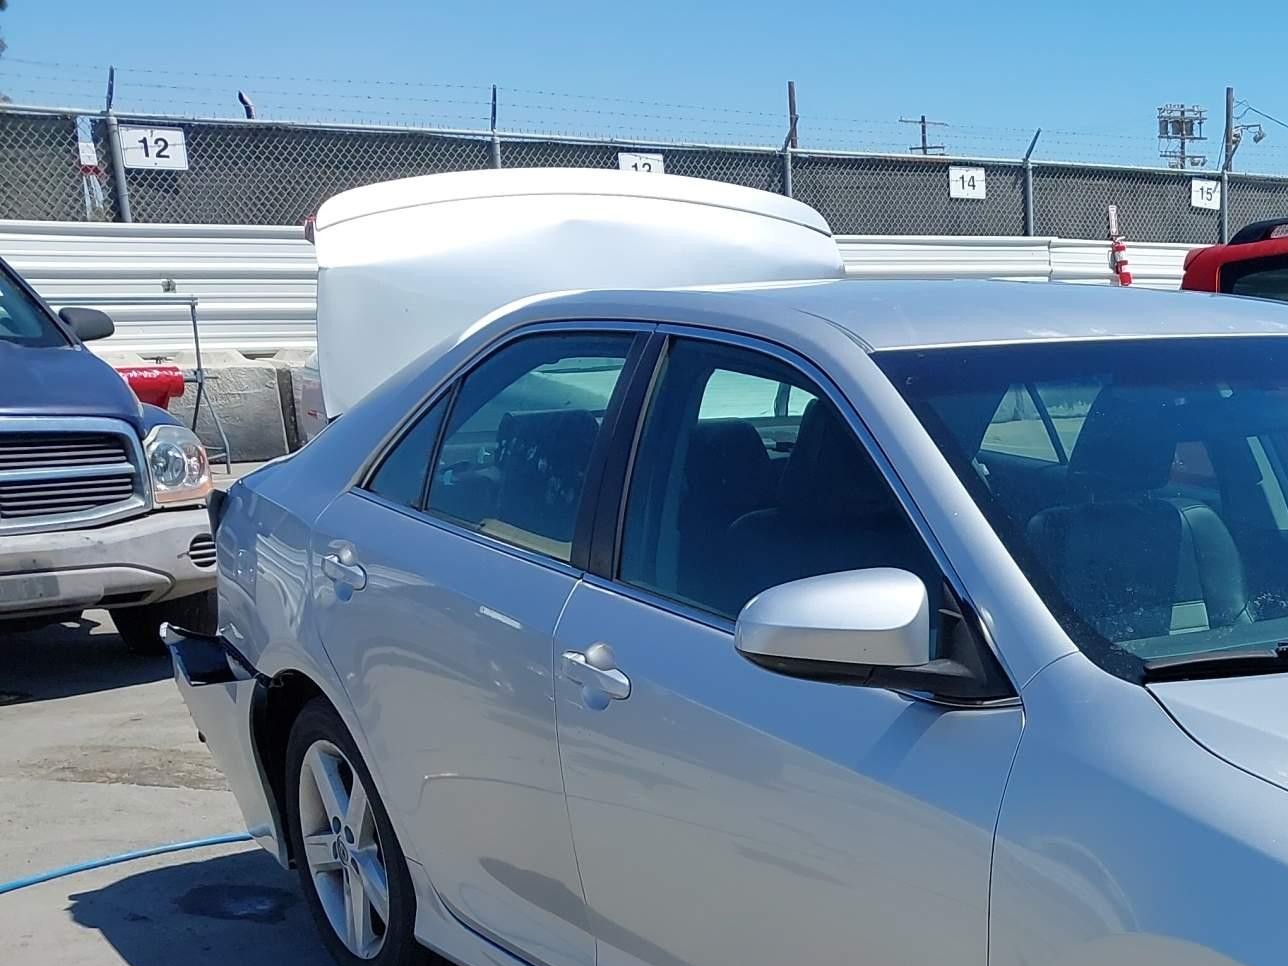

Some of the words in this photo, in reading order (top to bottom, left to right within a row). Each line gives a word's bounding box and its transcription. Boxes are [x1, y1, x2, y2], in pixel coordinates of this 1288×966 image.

[138, 137, 170, 158] 12
[960, 174, 976, 190] 14
[1200, 186, 1213, 201] 15
